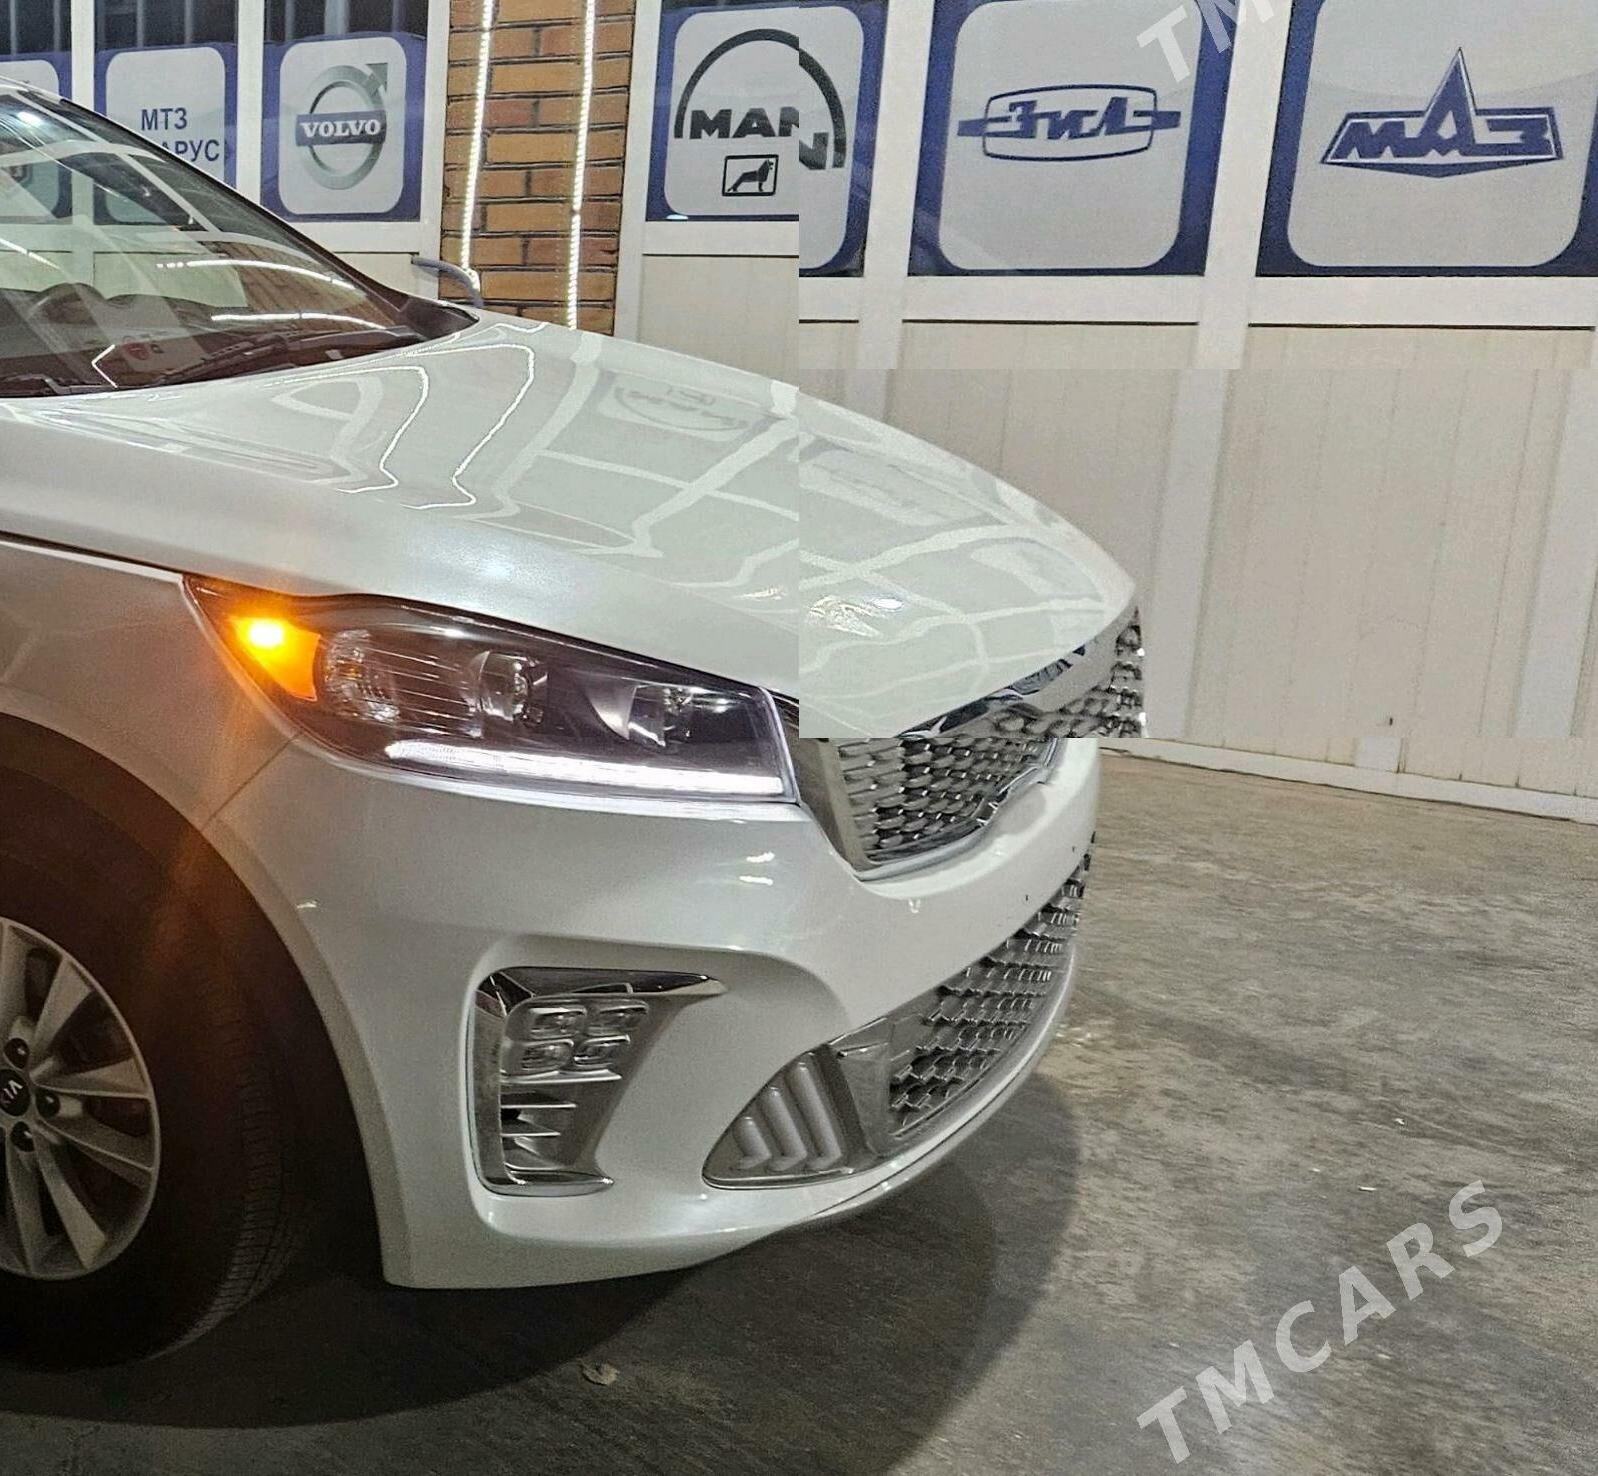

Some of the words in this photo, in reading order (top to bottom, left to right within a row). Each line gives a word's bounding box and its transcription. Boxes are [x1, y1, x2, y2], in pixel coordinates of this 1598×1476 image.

[140, 107, 188, 131] МТЗ
[300, 119, 382, 138] VOLVO
[689, 106, 830, 170] MAN
